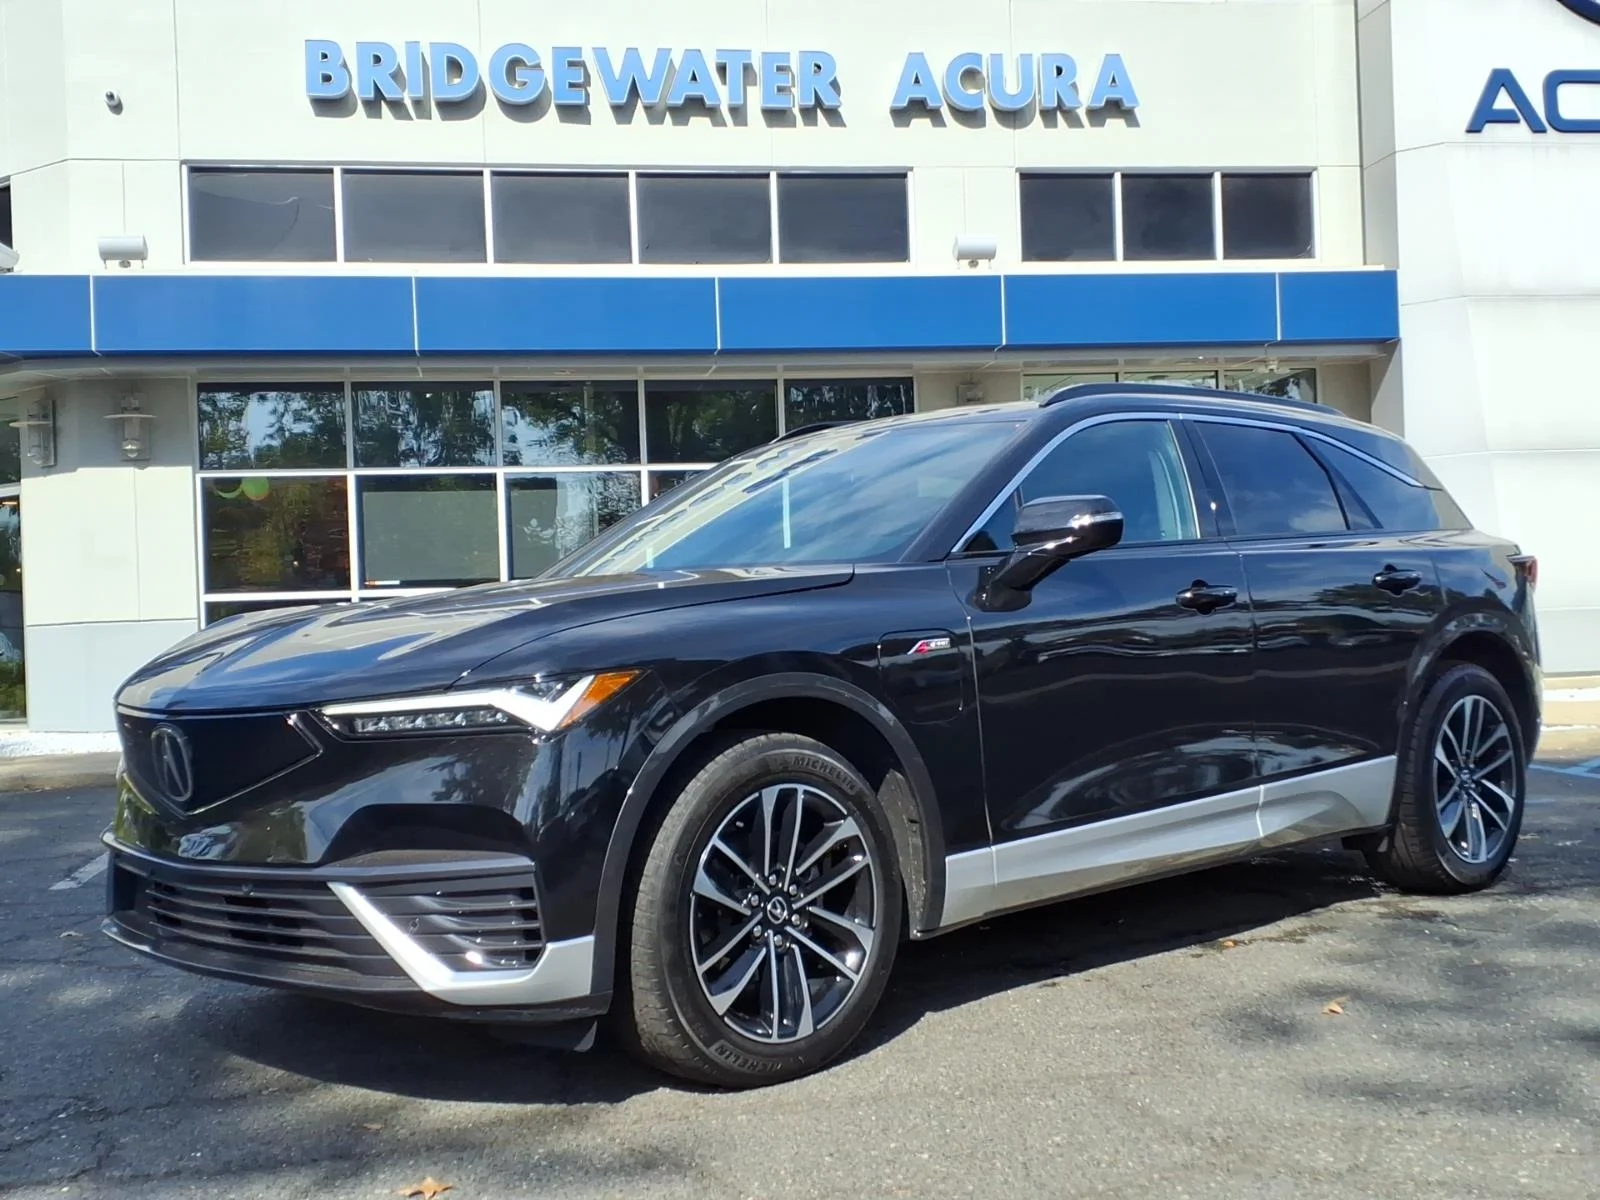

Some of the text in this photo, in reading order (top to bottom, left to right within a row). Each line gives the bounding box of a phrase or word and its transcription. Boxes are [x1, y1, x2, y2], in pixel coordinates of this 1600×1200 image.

[304, 39, 1139, 111] BRIDGEWATER ACURA
[792, 755, 857, 793] MICHELIN
